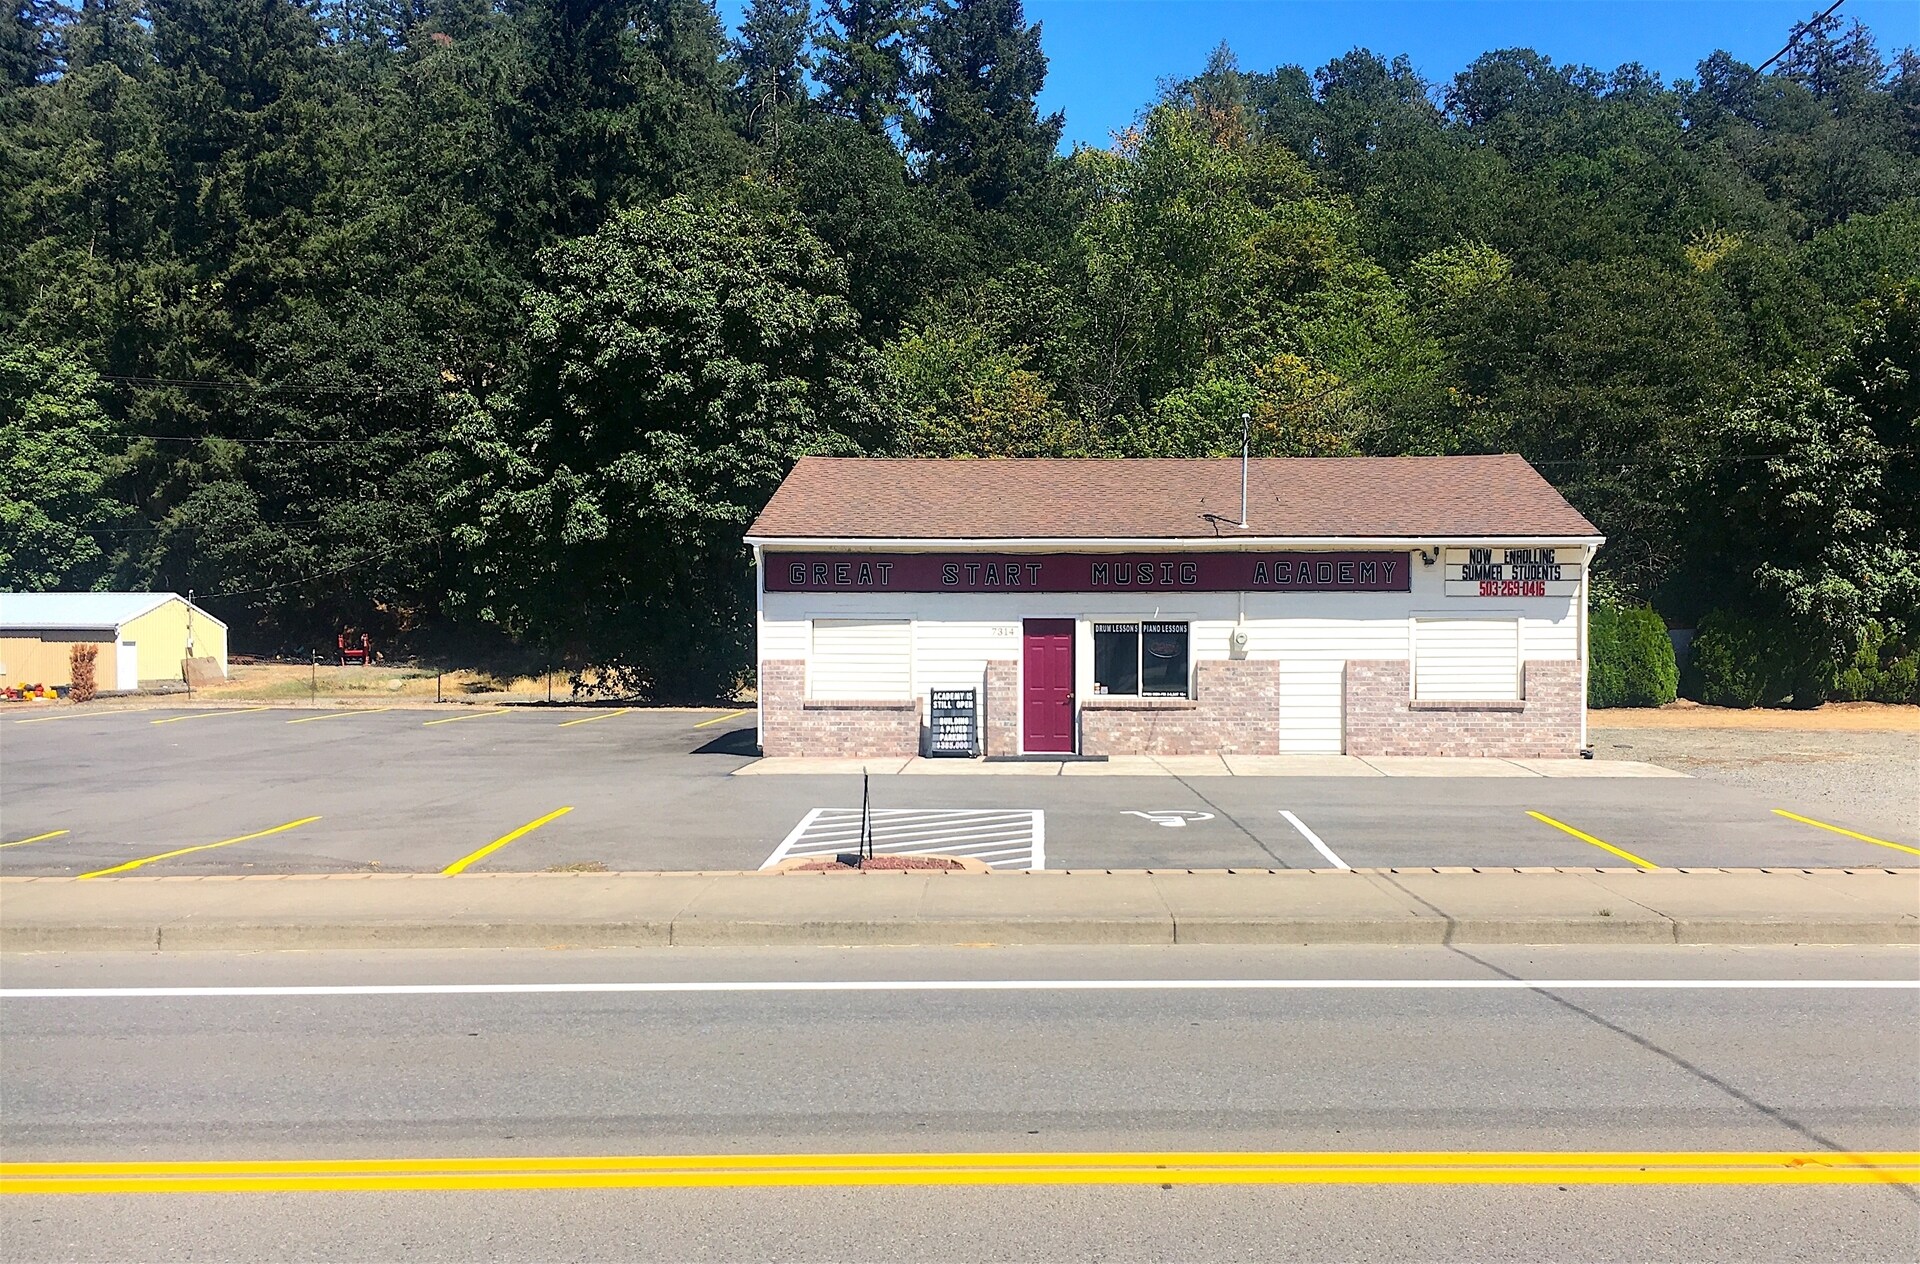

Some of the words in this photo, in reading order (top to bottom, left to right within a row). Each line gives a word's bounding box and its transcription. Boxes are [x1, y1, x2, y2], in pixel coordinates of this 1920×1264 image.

[1469, 549, 1492, 564] NOW
[1504, 549, 1555, 564] ENROLLING
[789, 563, 893, 585] GREAT
[942, 563, 1043, 586] START
[1091, 562, 1198, 585] MUSIC
[1253, 561, 1397, 585] ACADEMY
[1462, 565, 1502, 580] SUMMER
[1512, 565, 1561, 580] STUDENTS
[1479, 581, 1546, 597] 503-269-0416
[992, 627, 1014, 636] 7314
[1095, 624, 1112, 633] DRUM
[1112, 624, 1138, 633] LESSONS
[1143, 624, 1161, 633] PIANO
[1161, 624, 1188, 633] LESSONS
[933, 692, 965, 700] ACADEMY
[966, 692, 973, 700] IS
[933, 701, 952, 709] STILL
[956, 701, 974, 709] OPEN
[939, 717, 969, 725] BUILDING
[946, 725, 968, 733] PAVED
[939, 733, 968, 741] PARKING
